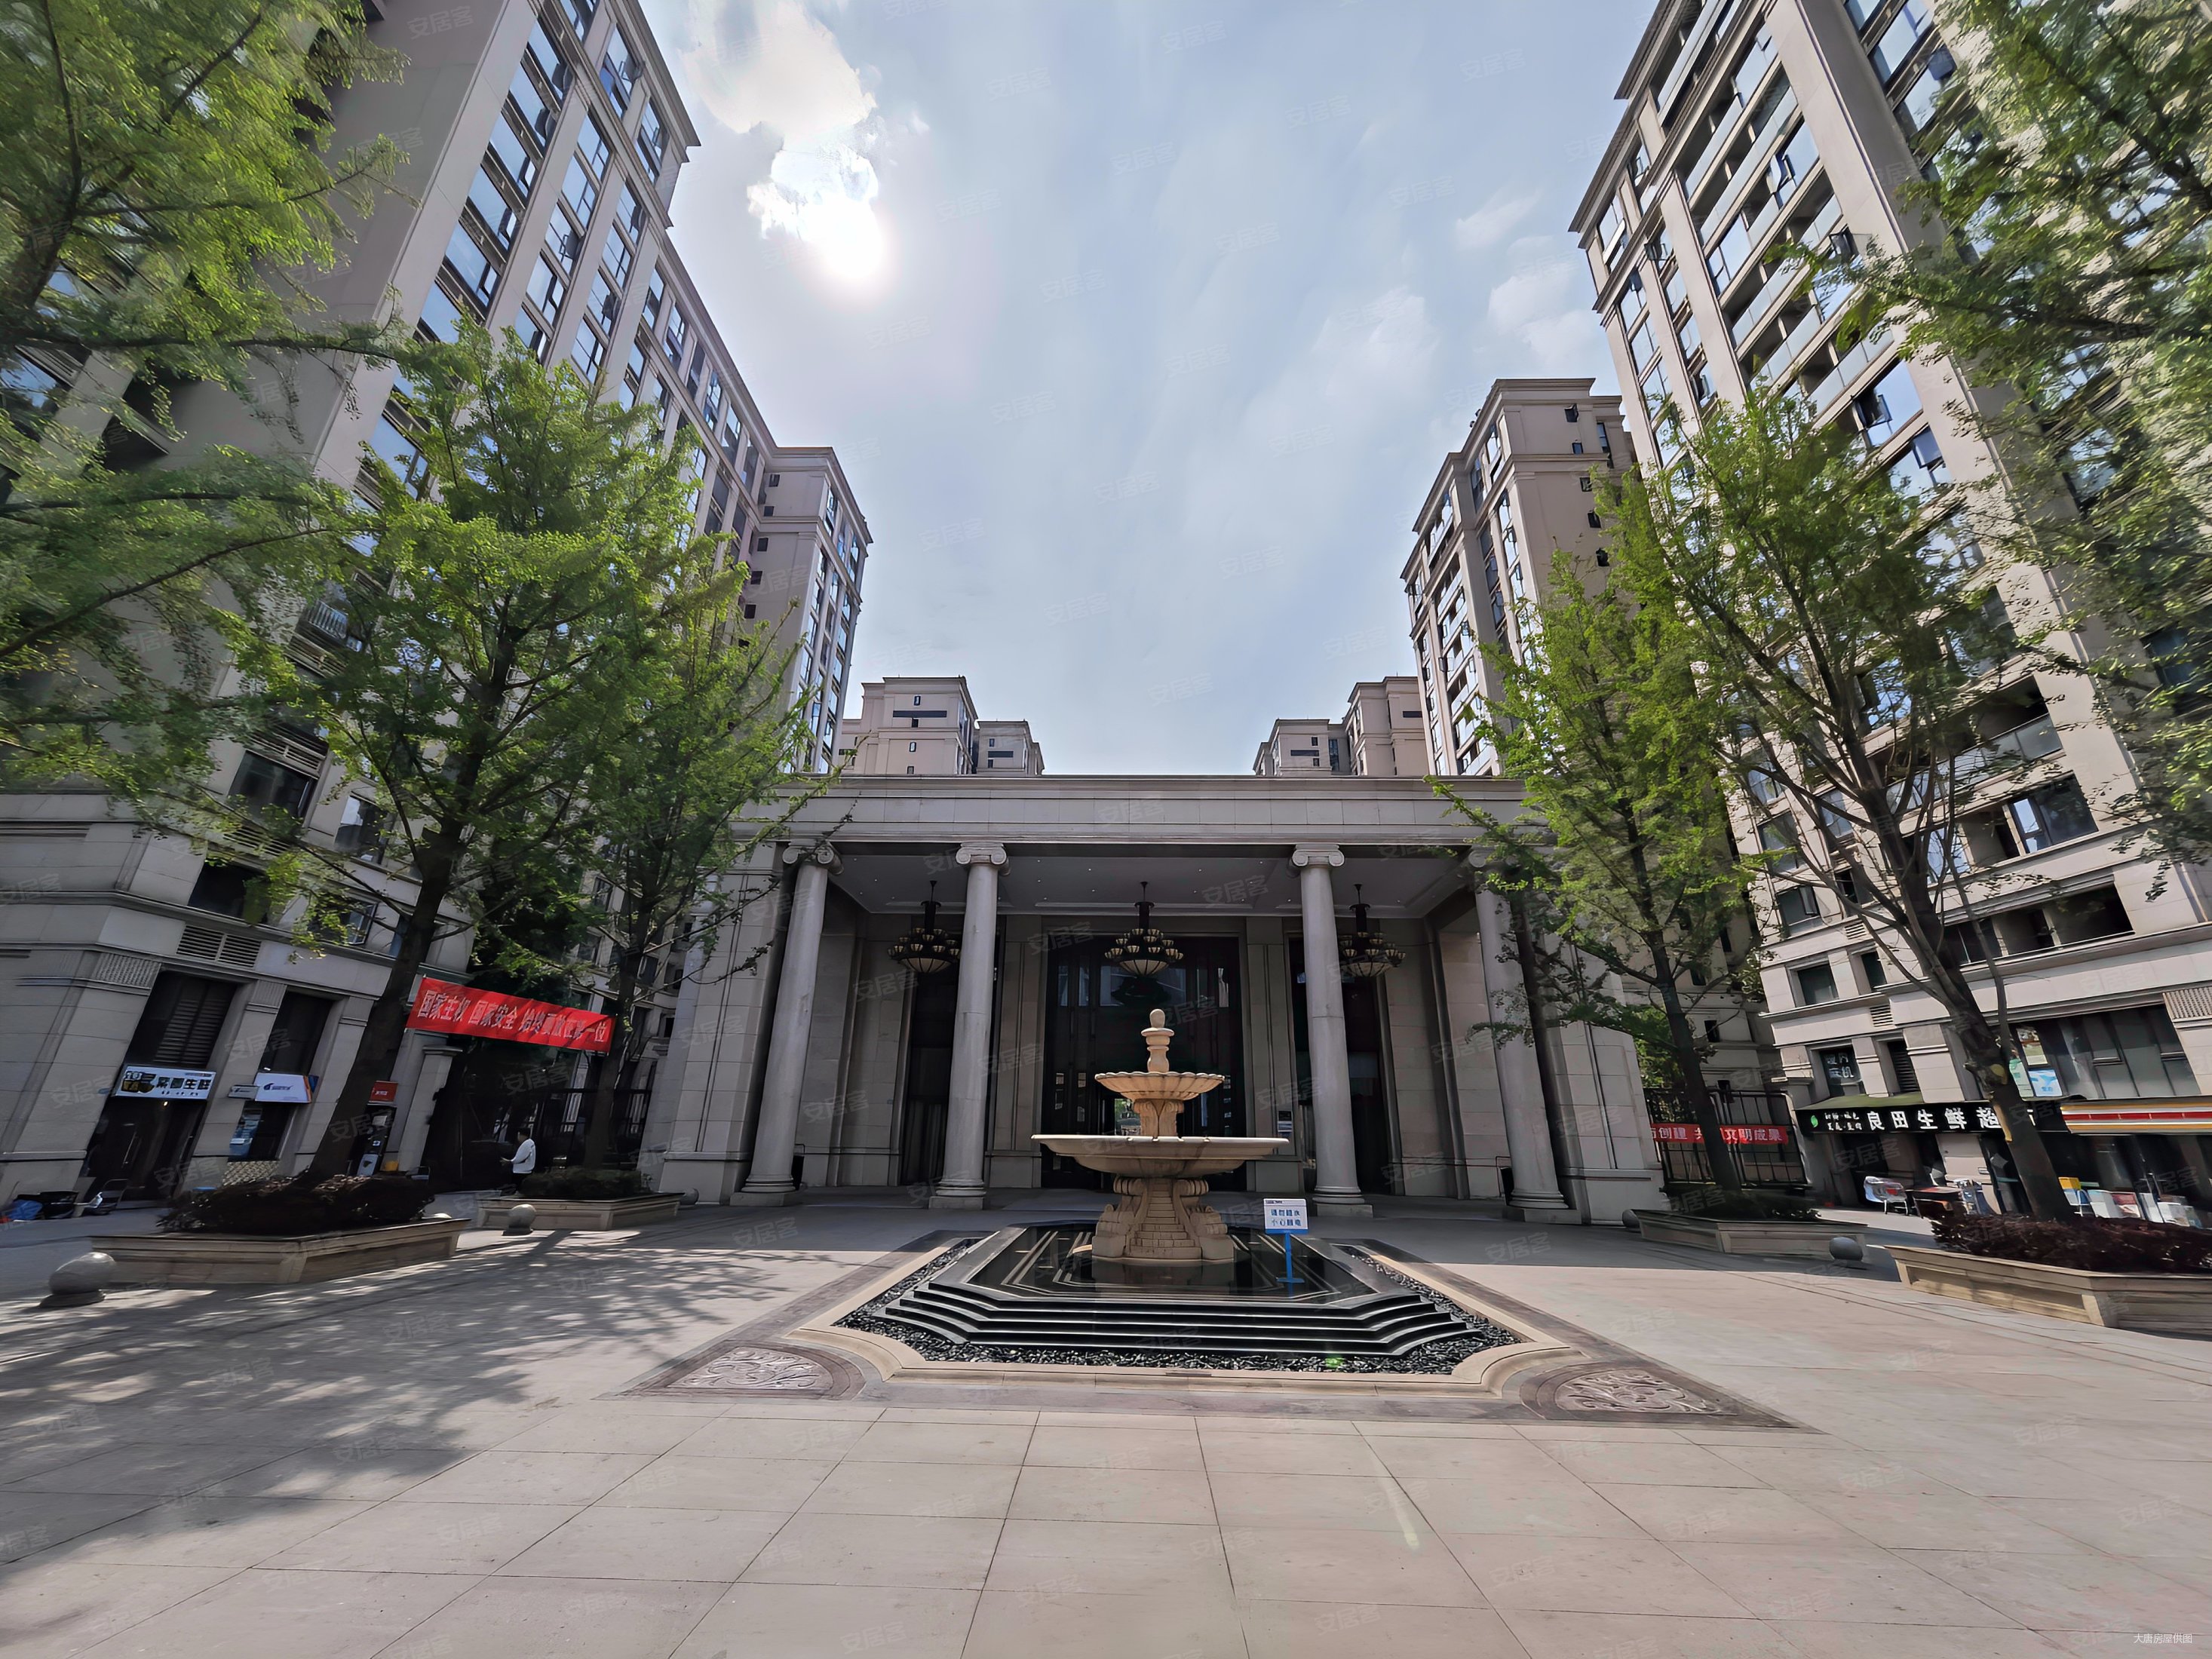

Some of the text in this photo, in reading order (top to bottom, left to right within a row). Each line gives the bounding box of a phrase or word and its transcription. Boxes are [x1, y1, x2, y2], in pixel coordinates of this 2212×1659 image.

[417, 989, 471, 1023] 国家主权
[468, 1000, 518, 1030] 国家安全
[1694, 1127, 1783, 1142] 共文明成果
